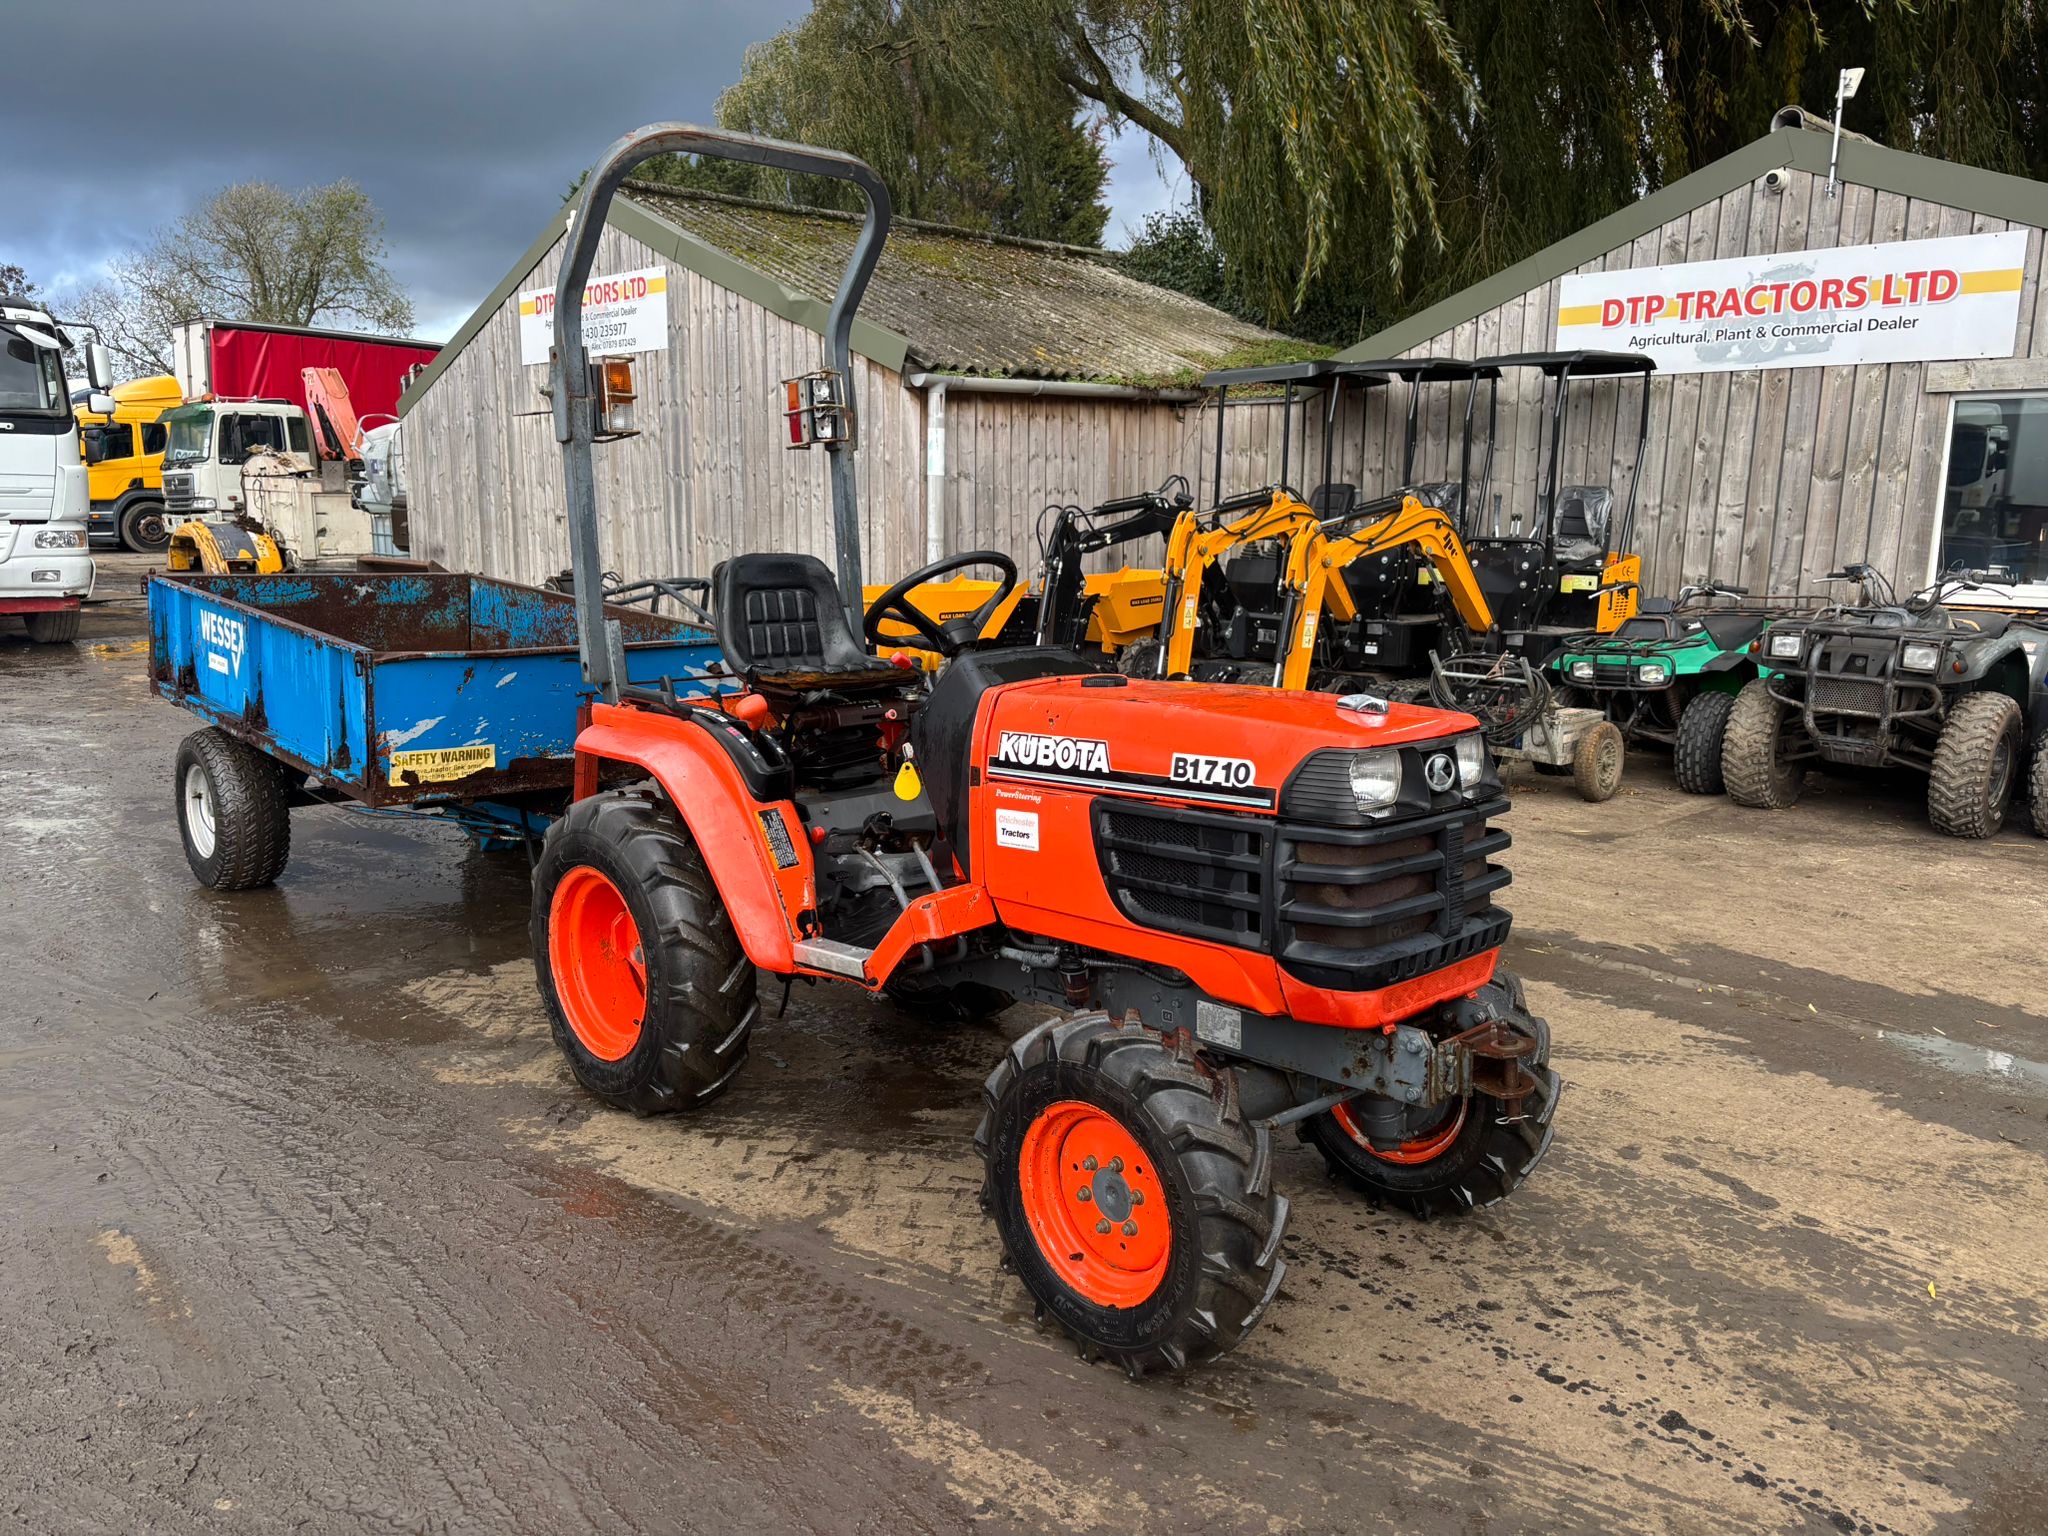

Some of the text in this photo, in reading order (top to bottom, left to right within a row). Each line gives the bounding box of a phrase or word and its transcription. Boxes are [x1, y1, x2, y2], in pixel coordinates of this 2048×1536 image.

[535, 293, 556, 315] DTP
[623, 276, 647, 300] LTD
[1601, 268, 1960, 328] DTP TRACTORS LTD
[589, 308, 619, 320] Commercial
[620, 306, 638, 317] Dealer
[599, 322, 627, 337] 235977
[1628, 315, 1918, 348] Agricultural, Plant & Commercial Dealer
[200, 608, 246, 656] WESSEX
[394, 747, 491, 767] SAFETY WARNING
[998, 732, 1110, 773] KUBOTA
[1173, 757, 1251, 786] B1710
[1001, 827, 1030, 839] Tractors
